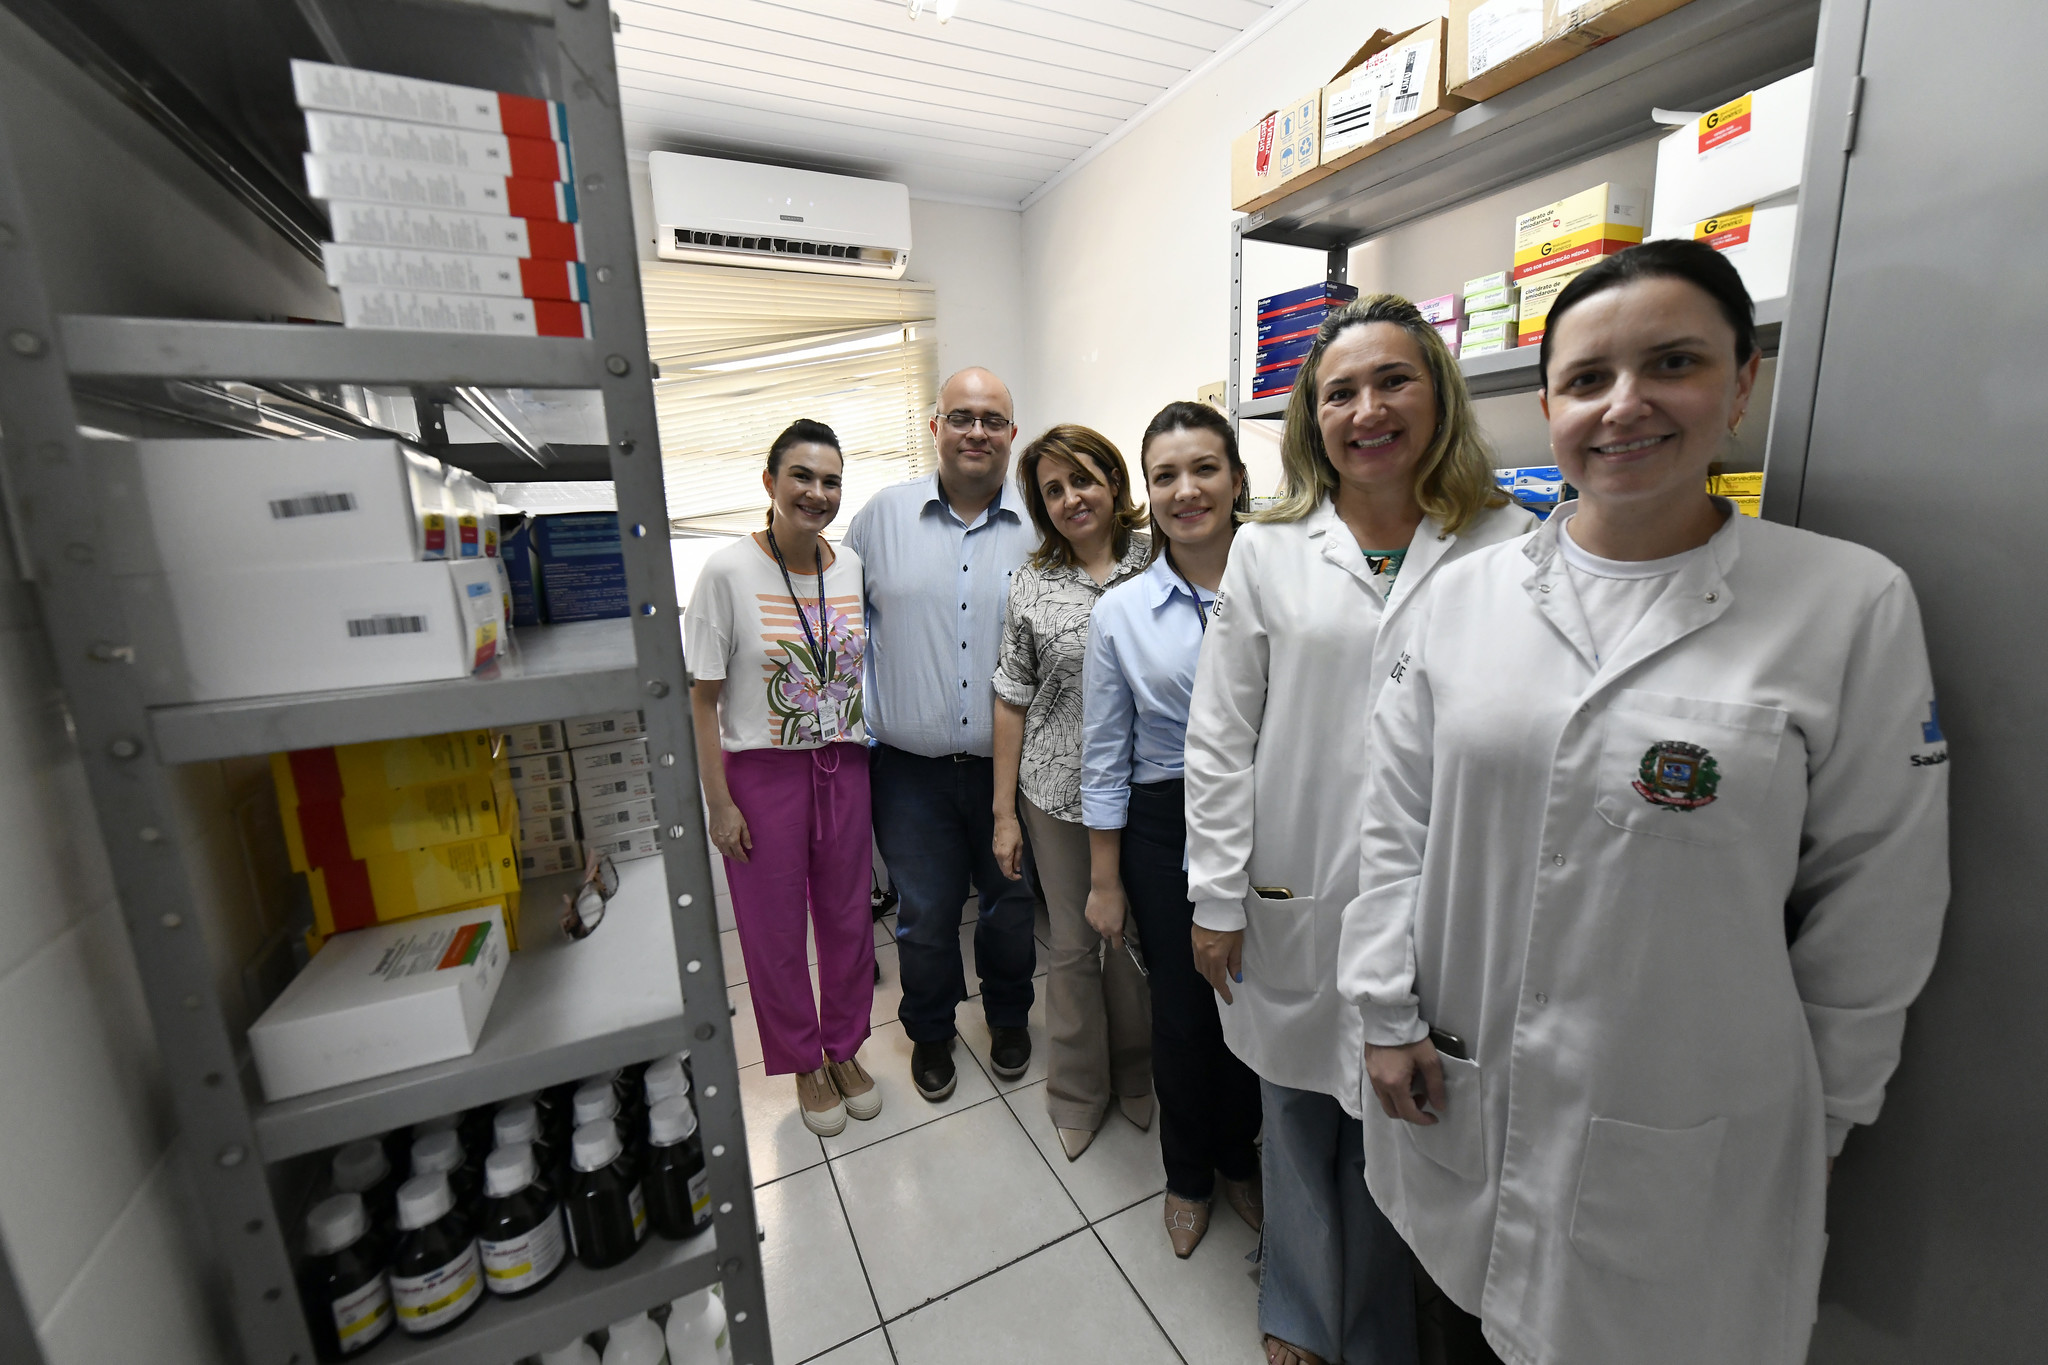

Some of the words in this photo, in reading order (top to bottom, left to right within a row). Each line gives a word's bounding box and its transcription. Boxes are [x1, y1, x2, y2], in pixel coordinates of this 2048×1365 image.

[1520, 212, 1546, 226] cloridrato
[1520, 216, 1551, 231] amiodarona
[1541, 242, 1552, 255] G
[1543, 254, 1570, 268] PRESCRIÇÃO
[1571, 248, 1590, 259] MÉDICA
[1525, 283, 1552, 295] cloridrato
[1525, 288, 1558, 300] amiodarona
